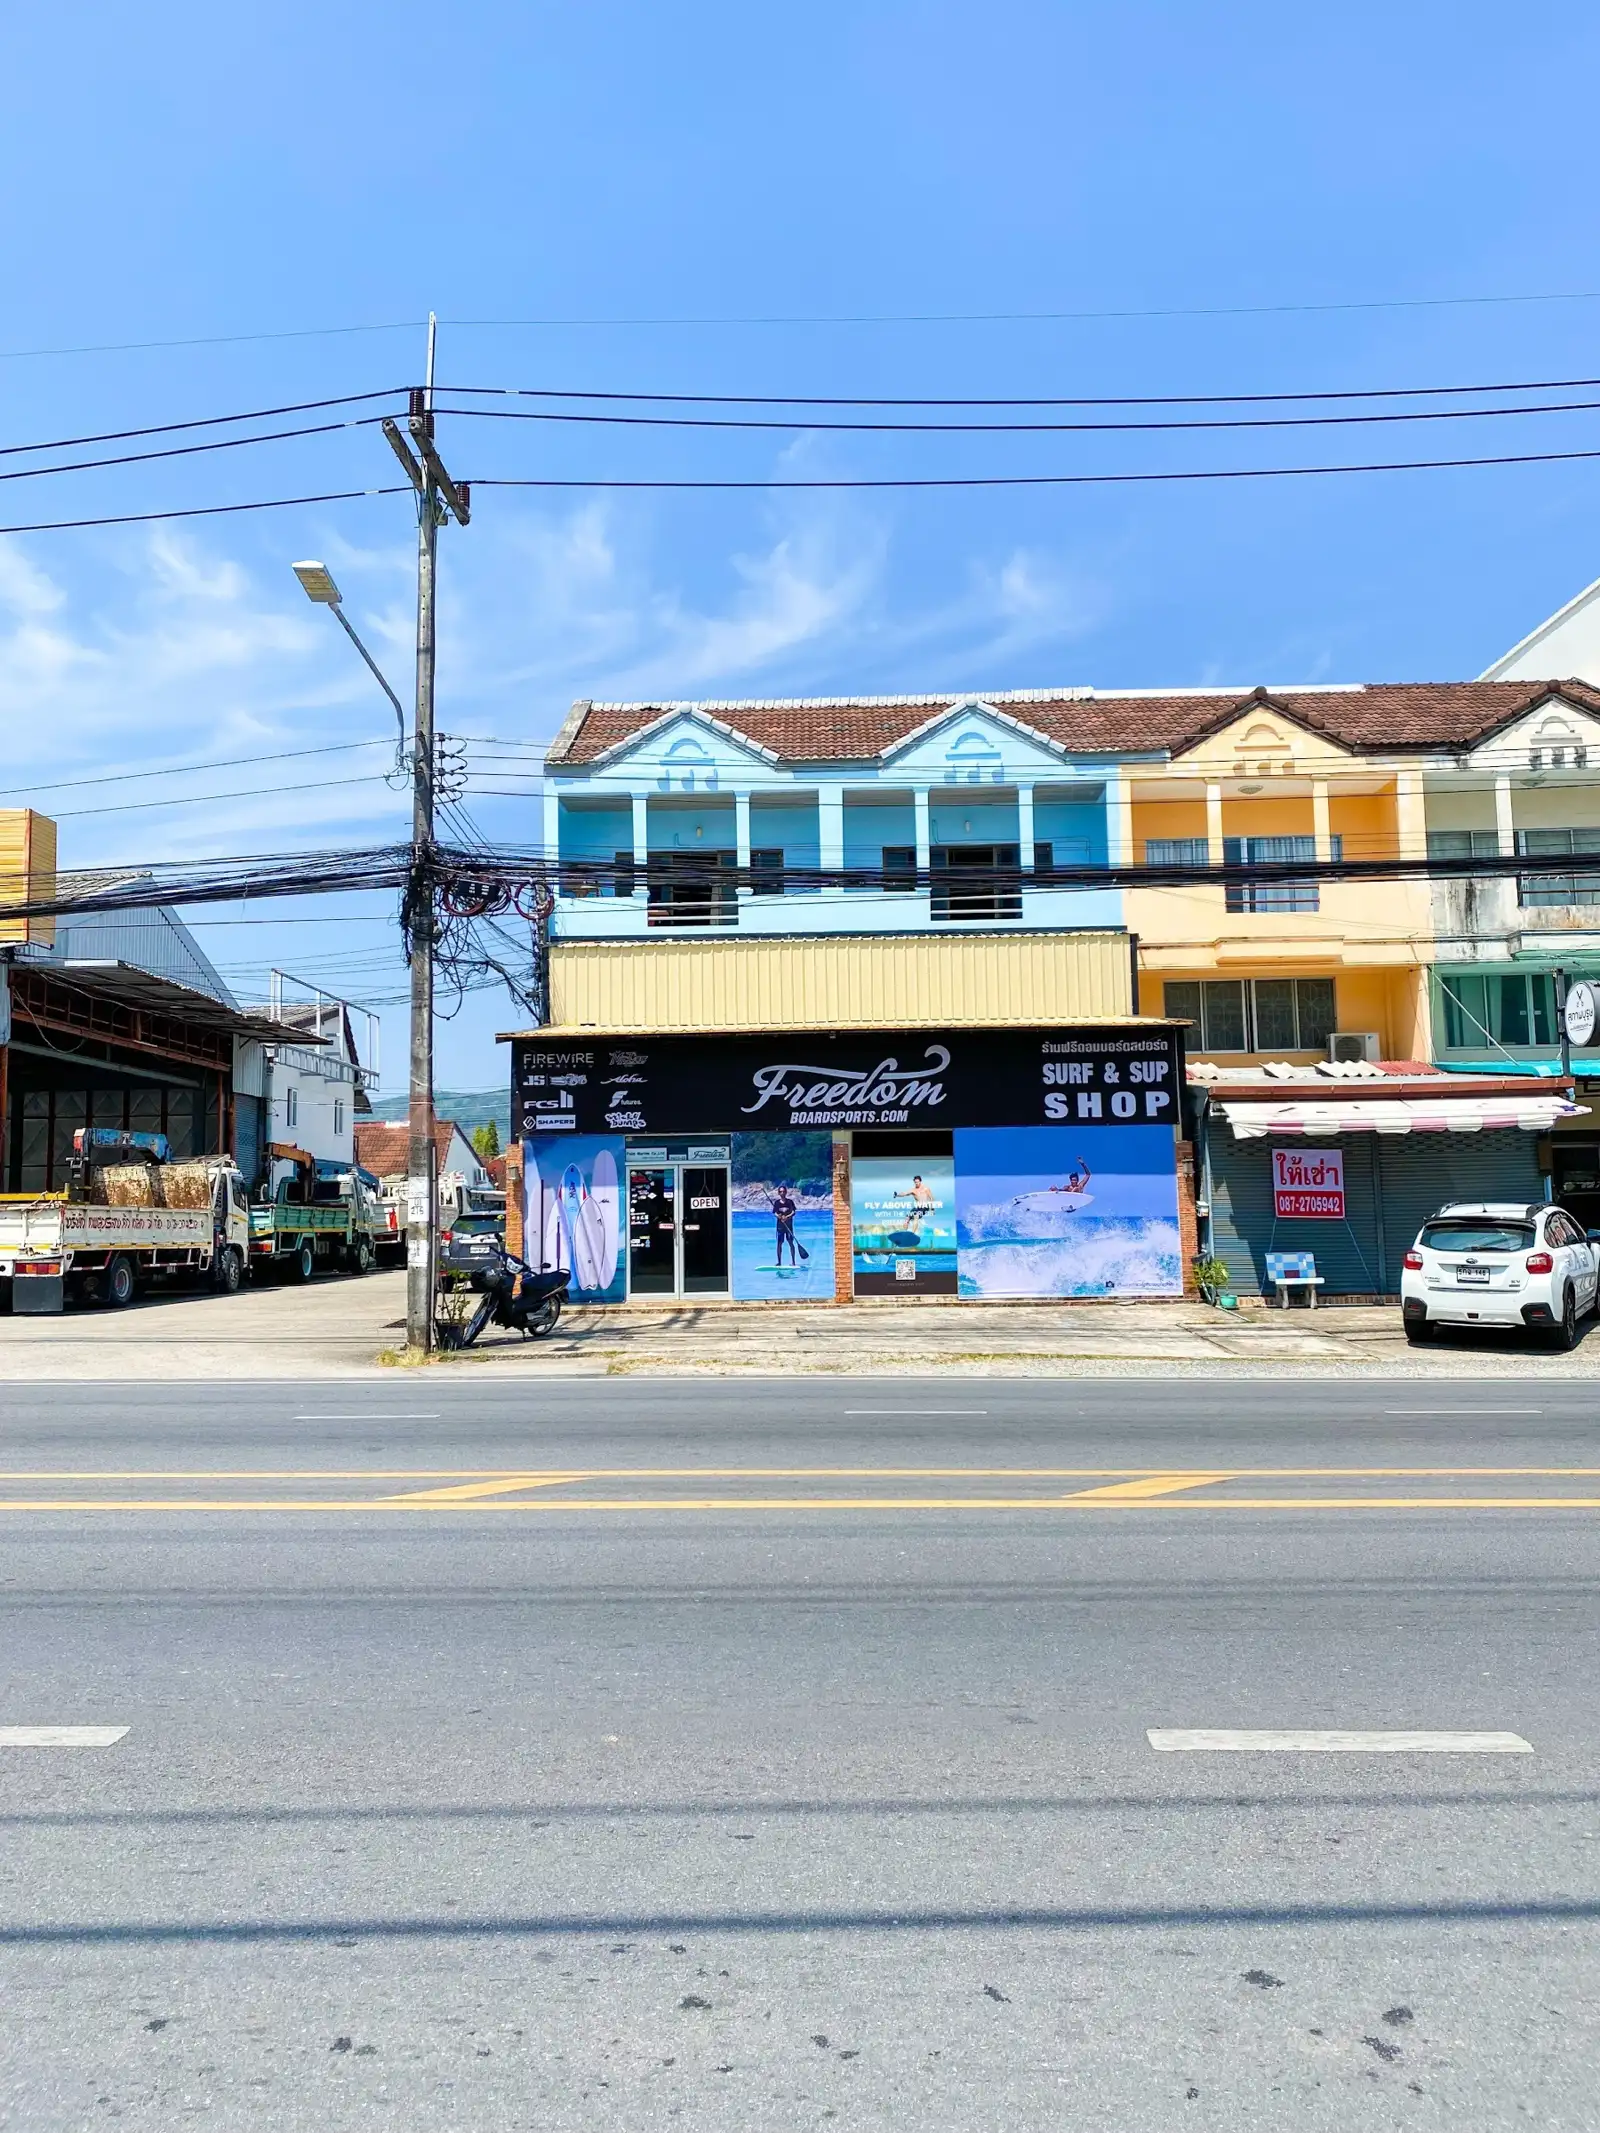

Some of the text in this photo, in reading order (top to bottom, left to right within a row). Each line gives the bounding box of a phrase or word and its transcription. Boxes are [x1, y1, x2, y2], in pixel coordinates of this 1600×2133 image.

[740, 1044, 950, 1113] Freedom
[1042, 1060, 1169, 1085] SURF & SUP
[522, 1075, 546, 1086] JS
[523, 1100, 559, 1109] FCS
[1044, 1091, 1170, 1119] SHOP
[790, 1109, 909, 1124] BOARDSPORTS.COM
[1276, 1152, 1339, 1186] ให้เช่า
[692, 1199, 719, 1208] OPEN
[864, 1200, 943, 1209] FLY ABOVE WATER
[1279, 1196, 1340, 1212] 087-2705942
